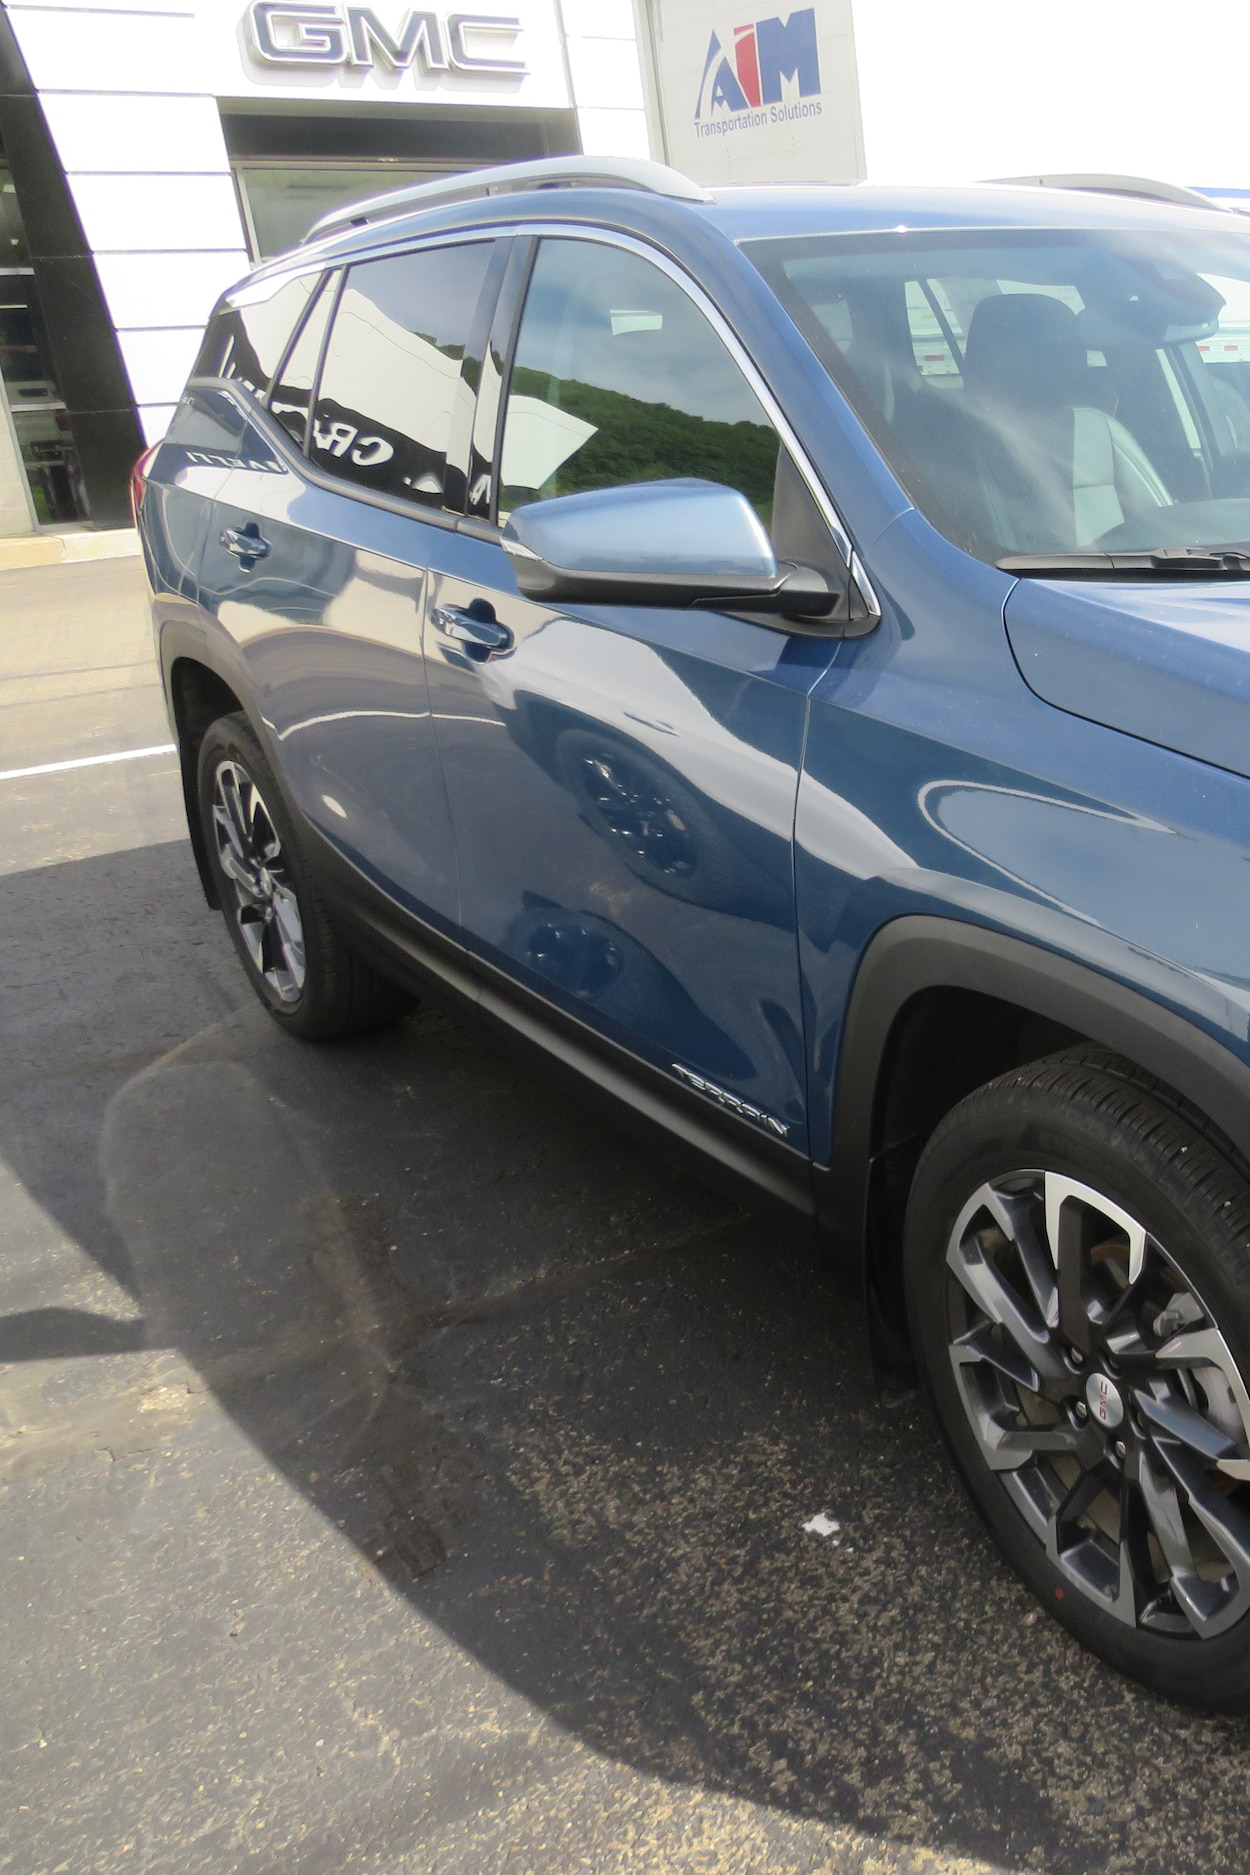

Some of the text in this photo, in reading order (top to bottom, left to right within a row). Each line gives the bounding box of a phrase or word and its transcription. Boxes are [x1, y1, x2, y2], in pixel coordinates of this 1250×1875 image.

[250, 1, 531, 75] GMC
[694, 101, 823, 138] Transportation Solutions
[1099, 1380, 1108, 1421] GMC
